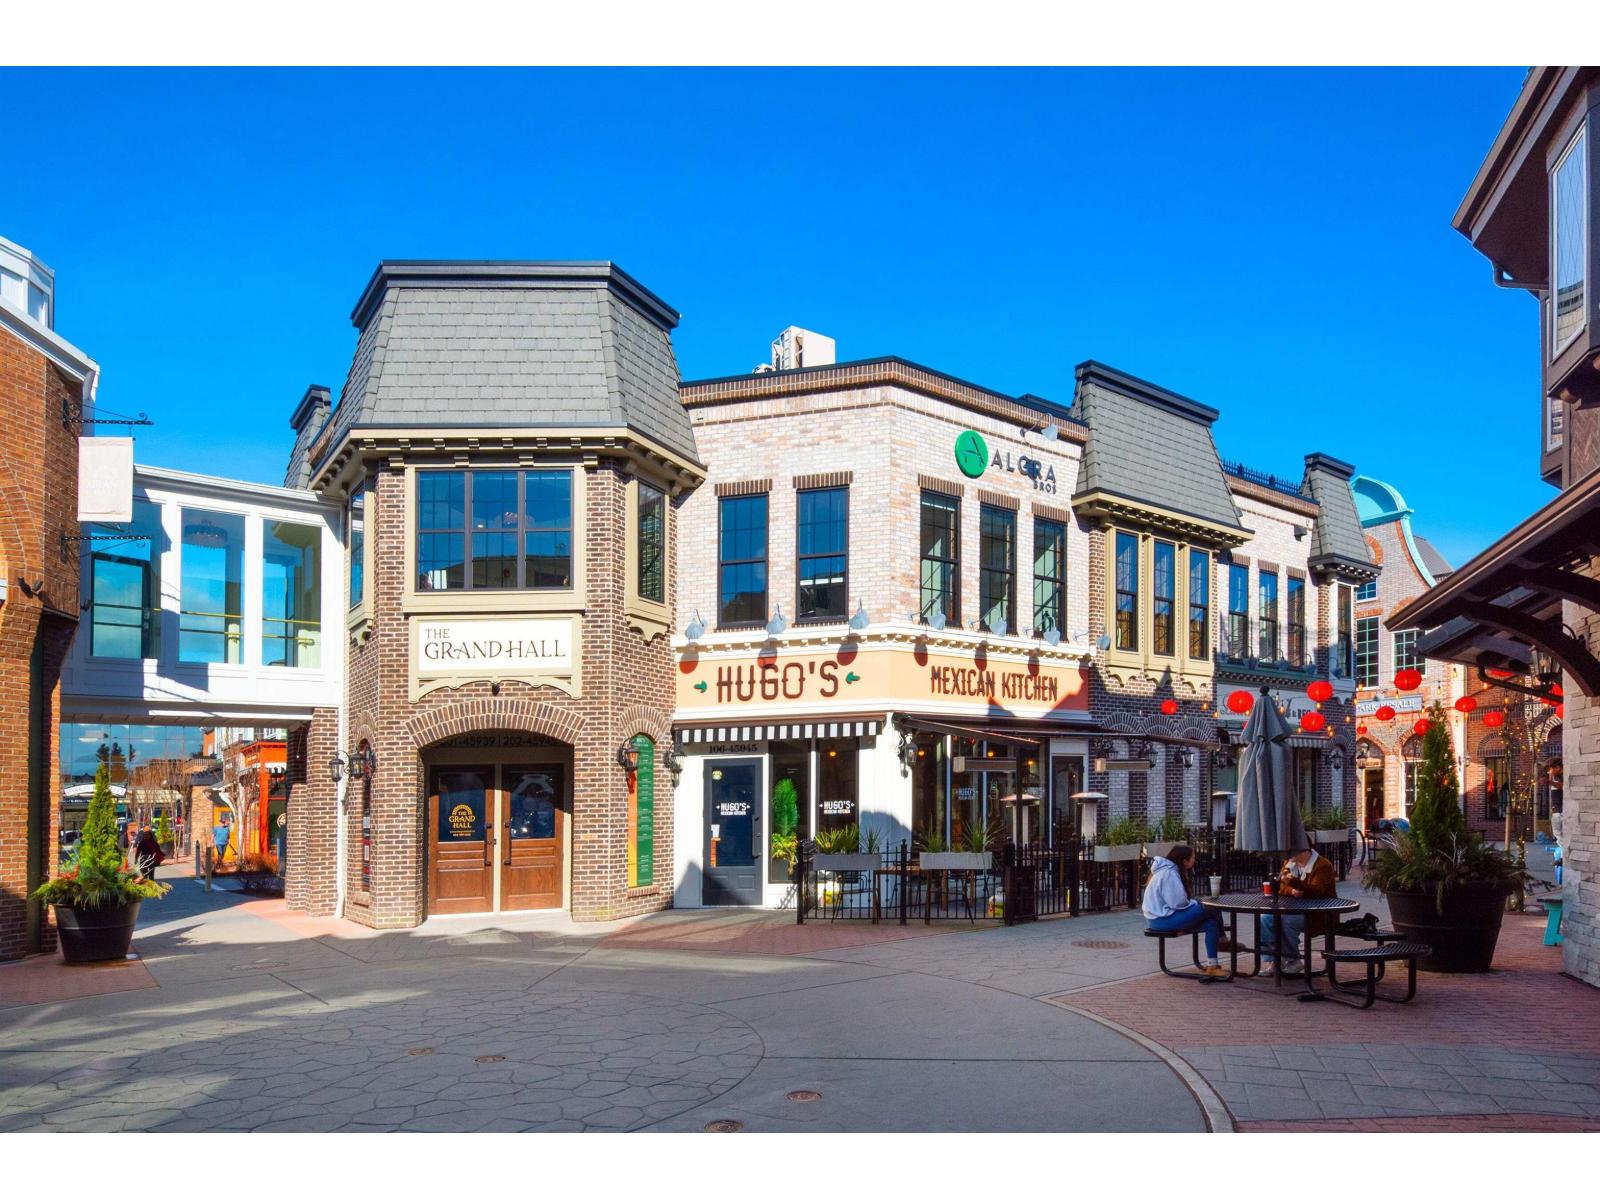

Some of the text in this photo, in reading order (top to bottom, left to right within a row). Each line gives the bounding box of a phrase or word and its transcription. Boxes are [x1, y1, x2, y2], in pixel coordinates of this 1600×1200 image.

[991, 448, 1056, 484] ALGRA
[1033, 480, 1057, 495] BROS
[425, 628, 450, 639] THE
[424, 639, 566, 660] GRAND HALL
[716, 660, 839, 704] HUGO'S
[930, 665, 1058, 702] MEXICAN KITCHEN
[709, 744, 758, 754] 106-45945
[721, 803, 747, 811] HUGO'S
[824, 800, 851, 810] HUGO'S
[449, 815, 476, 823] GRAND
